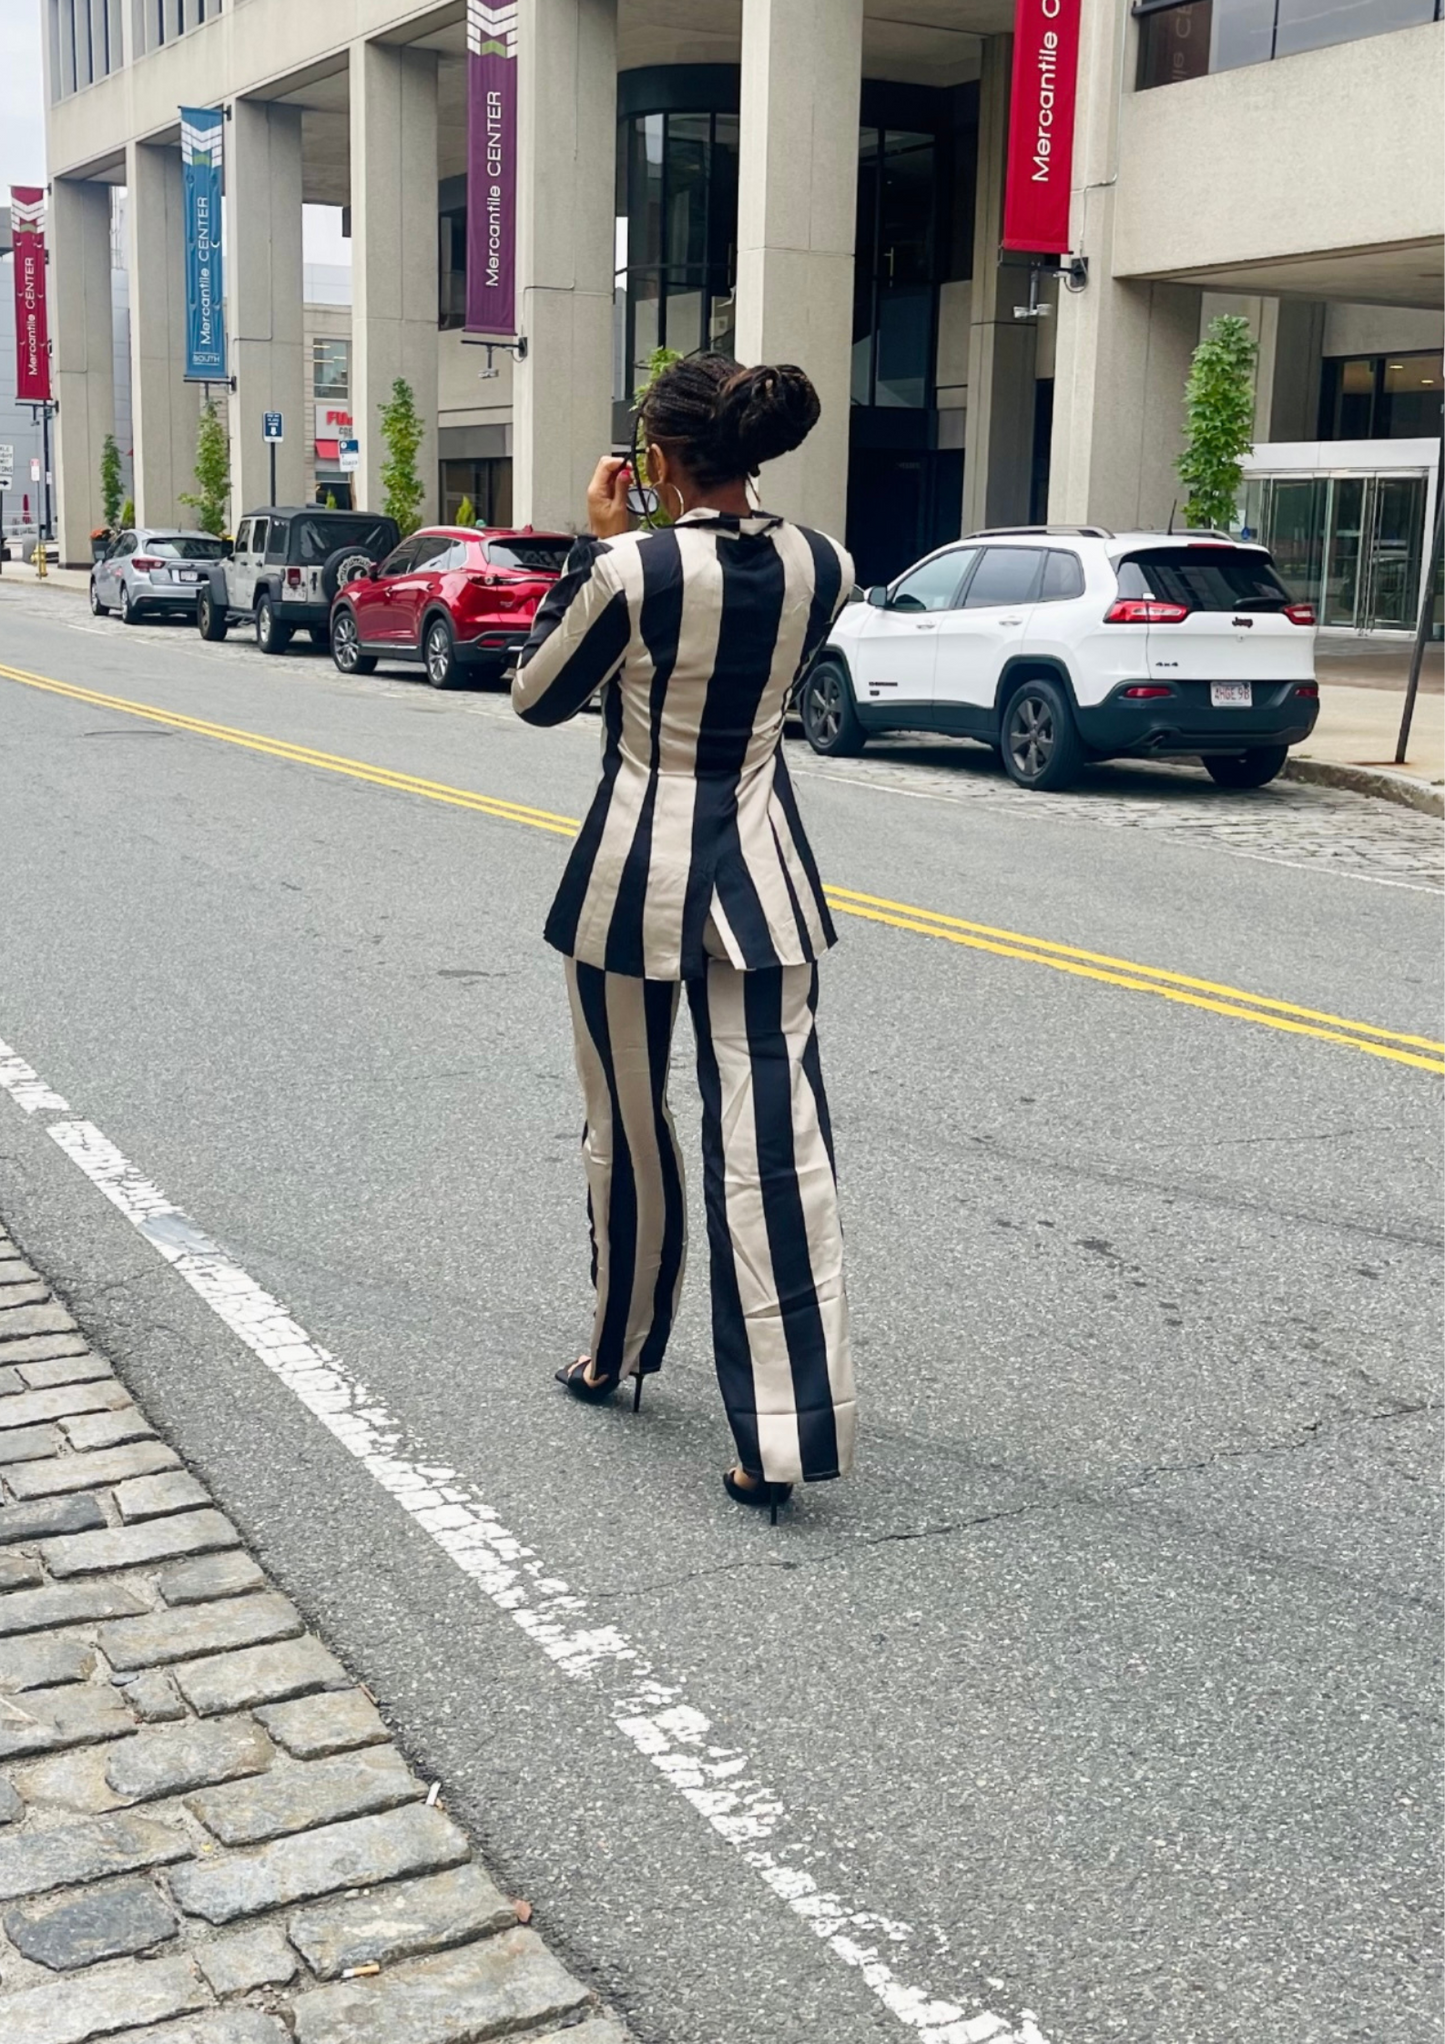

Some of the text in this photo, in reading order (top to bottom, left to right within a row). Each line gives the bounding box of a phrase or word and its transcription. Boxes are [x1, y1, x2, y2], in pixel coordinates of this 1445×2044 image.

[1031, 31, 1058, 182] Mercantile
[486, 91, 501, 286] Mercantile CENTER
[25, 257, 38, 376] Mercantile CENTER
[197, 196, 211, 345] Mercantile CENTER
[192, 354, 220, 363] SOUTH
